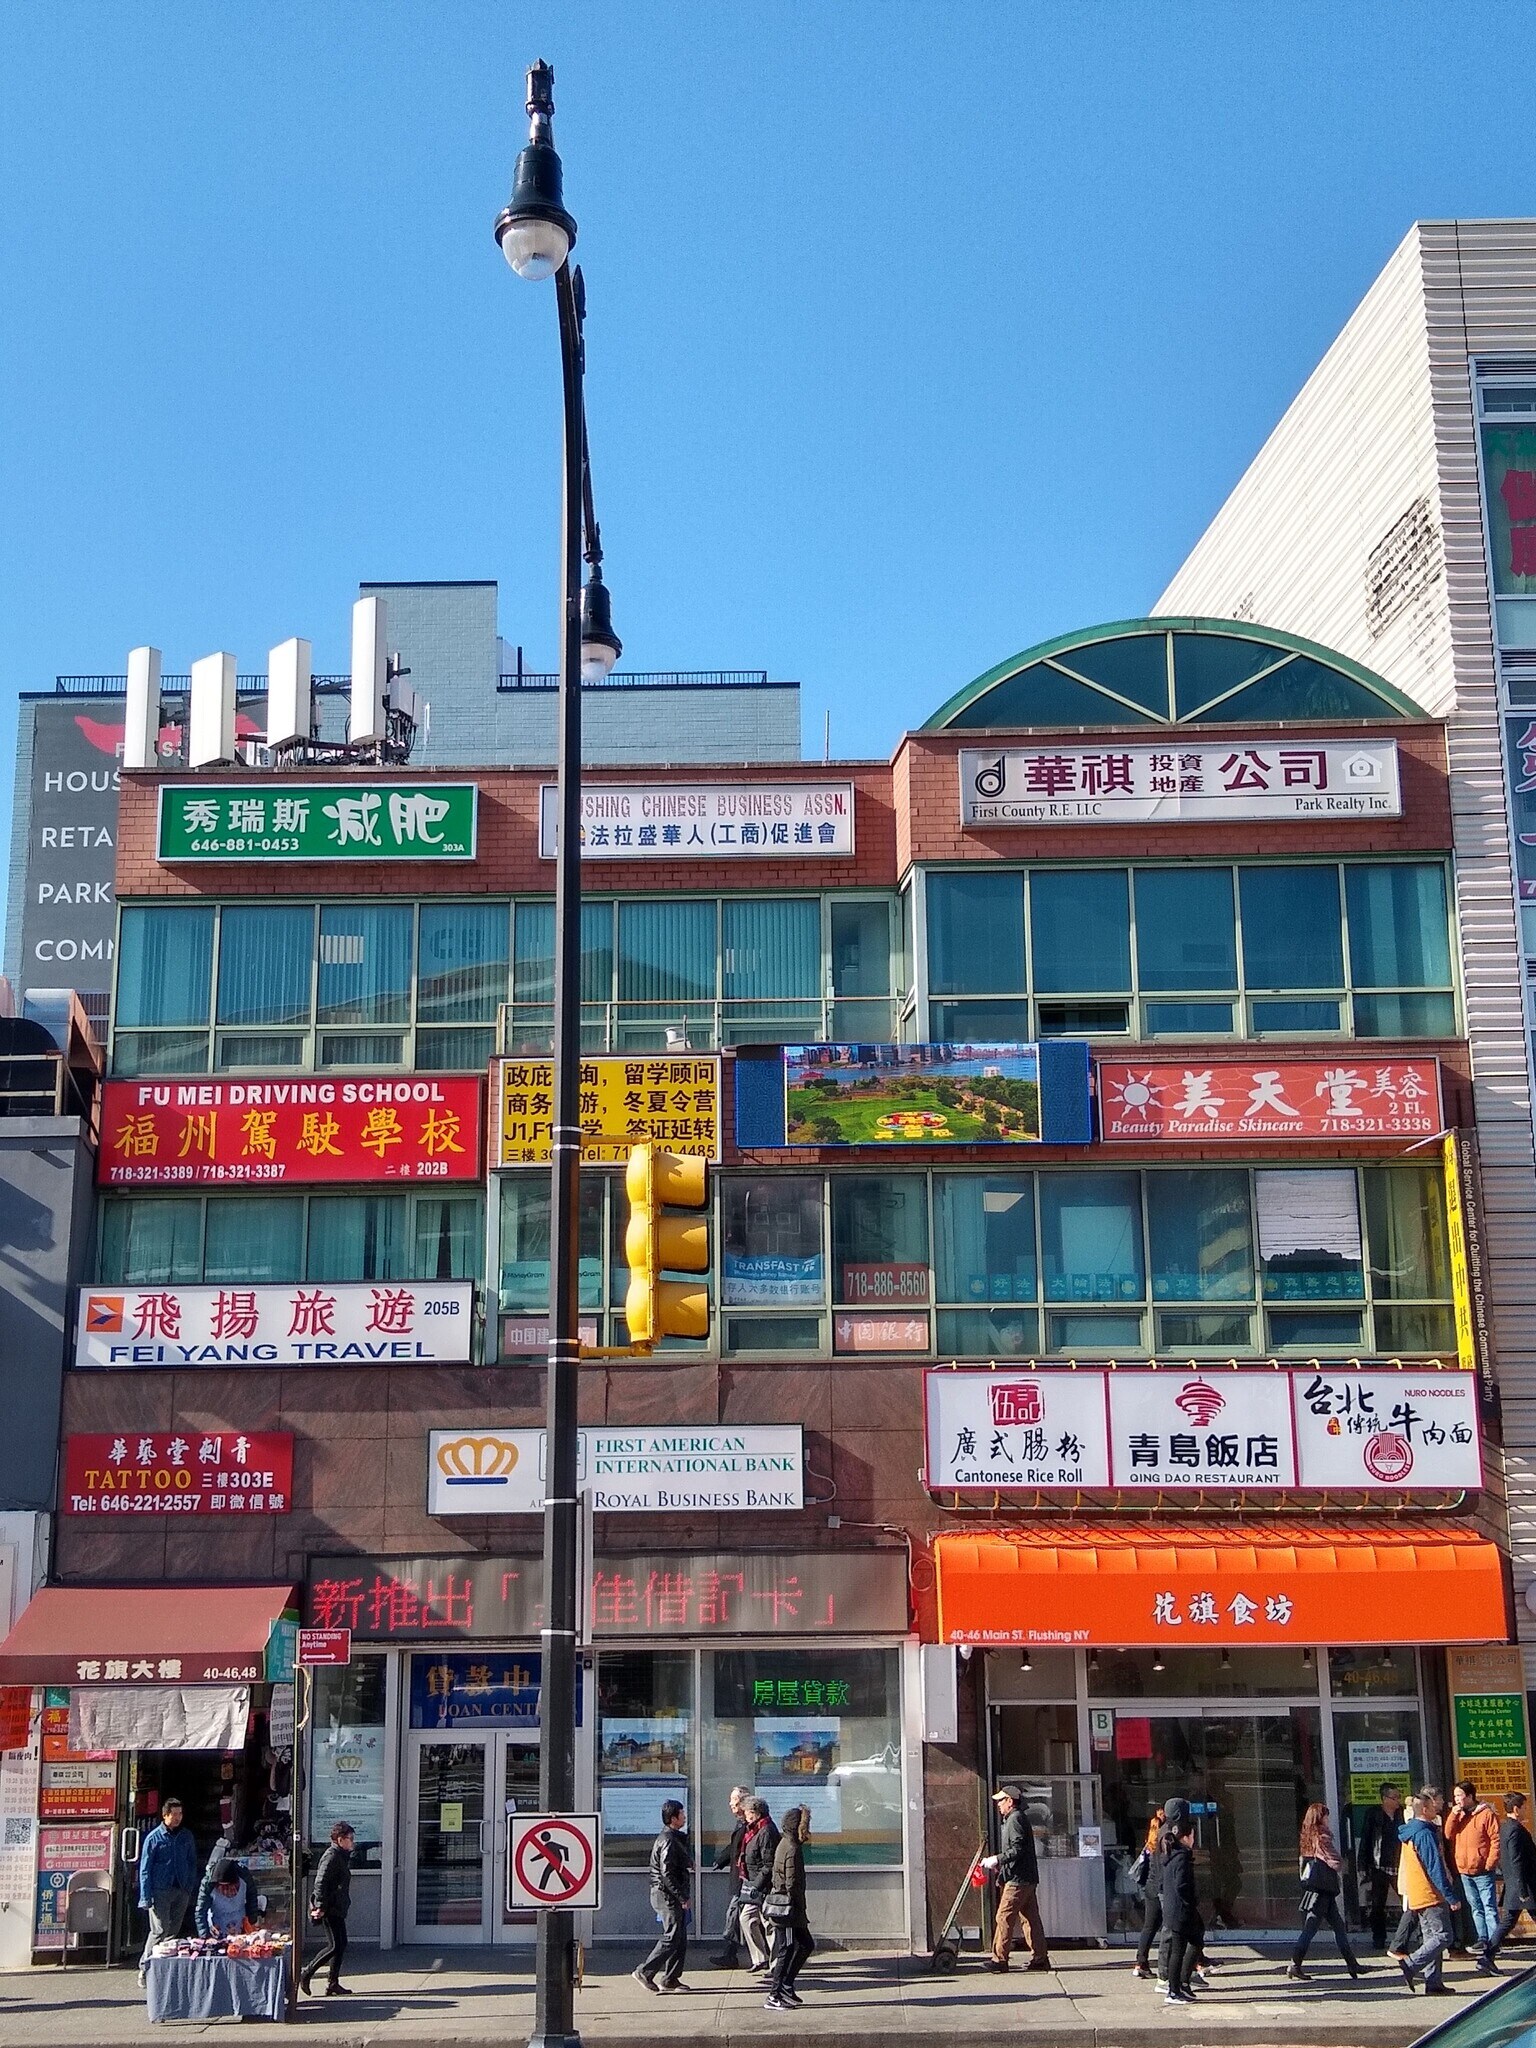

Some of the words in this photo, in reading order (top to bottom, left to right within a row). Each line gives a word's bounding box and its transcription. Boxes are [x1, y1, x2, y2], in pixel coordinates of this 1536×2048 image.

[1024, 754, 1134, 797] 華祺
[1218, 750, 1327, 792] 公司
[581, 796, 631, 818] SHING
[642, 795, 707, 817] CHINESE
[717, 794, 793, 817] BUSINESS
[804, 793, 847, 816] ASSN.
[972, 805, 999, 817] First
[1002, 804, 1046, 820] County
[1076, 803, 1102, 816] LLC
[1295, 798, 1323, 811] Park
[1326, 796, 1368, 812] Realty
[1371, 795, 1391, 809] Inc.
[182, 798, 311, 834] 秀瑞斯
[41, 827, 114, 848] RETA
[191, 838, 299, 851] 646-881-0453
[442, 843, 465, 852] 303A
[38, 882, 112, 904] PARK
[624, 1062, 714, 1086] 留学顾问
[138, 1086, 171, 1106] FU
[177, 1085, 222, 1105] MEI
[229, 1084, 335, 1105] DRIVING
[342, 1082, 445, 1104] SCHOOL
[623, 1090, 715, 1114] 冬夏令营
[1173, 1068, 1367, 1119] 美天堂
[1370, 1066, 1428, 1099] 美容
[1389, 1102, 1399, 1115] 2
[626, 1117, 715, 1141] 签证延转
[1110, 1120, 1164, 1134] Beauty
[1167, 1118, 1234, 1133] Paradise
[1236, 1117, 1303, 1132] Skincare
[1320, 1117, 1432, 1132] 718-321-3338
[507, 1148, 535, 1162] 三楼
[1461, 1140, 1471, 1167] Global
[110, 1166, 193, 1180] 718-321-3389
[202, 1165, 286, 1179] 718-321-3387
[417, 1161, 448, 1175] 202B
[1463, 1168, 1474, 1200] Service
[1466, 1201, 1477, 1228] Center
[1469, 1229, 1478, 1243] for
[734, 1260, 800, 1272] TRANSFAST
[1470, 1244, 1481, 1277] Quitting
[579, 1270, 601, 1278] yGram
[848, 1270, 926, 1297] 718-886-8560
[1473, 1278, 1482, 1292] the
[131, 1288, 415, 1341] 飛揚旅遊
[424, 1301, 460, 1316] 205B
[1475, 1294, 1486, 1328] Chinese
[110, 1345, 164, 1362] FEI
[177, 1343, 279, 1362] YANG
[291, 1341, 435, 1360] TRAVEL
[1479, 1330, 1492, 1378] Communist
[1304, 1375, 1374, 1415] 台北
[1404, 1389, 1427, 1398] NURO
[1428, 1389, 1465, 1397] NOODLES
[1484, 1380, 1494, 1403] Party
[595, 1438, 646, 1454] FIRST
[649, 1437, 745, 1452] AMERICAN
[950, 1427, 1086, 1464] 廣式腸粉
[1128, 1433, 1279, 1468] 青島飯店
[595, 1459, 742, 1474] INTERNATIONAL
[746, 1457, 795, 1472] BANK
[955, 1468, 1024, 1483] Cantonese
[1027, 1468, 1056, 1483] Rice
[1058, 1468, 1083, 1482] Roll
[85, 1469, 192, 1489] TATTOO
[1130, 1474, 1160, 1484] QING
[1164, 1474, 1190, 1484] DAO
[1195, 1474, 1281, 1483] RESTAURANT
[71, 1495, 97, 1511] Tel:
[101, 1495, 201, 1511] 646-221-2557
[312, 1571, 835, 1630] 新推出「佳借記卡」
[1152, 1592, 1294, 1626] 花旗食坊
[302, 1641, 327, 1649] Anytime
[950, 1630, 981, 1640] 40-46
[982, 1630, 1010, 1640] Main
[1028, 1629, 1071, 1642] Flushing
[1074, 1629, 1090, 1640] NY
[76, 1659, 183, 1681] 花旗大樓
[203, 1666, 257, 1680] 40-46,48
[752, 1680, 849, 1706] 房屋貸款
[490, 1702, 541, 1716] CENT
[1097, 1714, 1107, 1729] B
